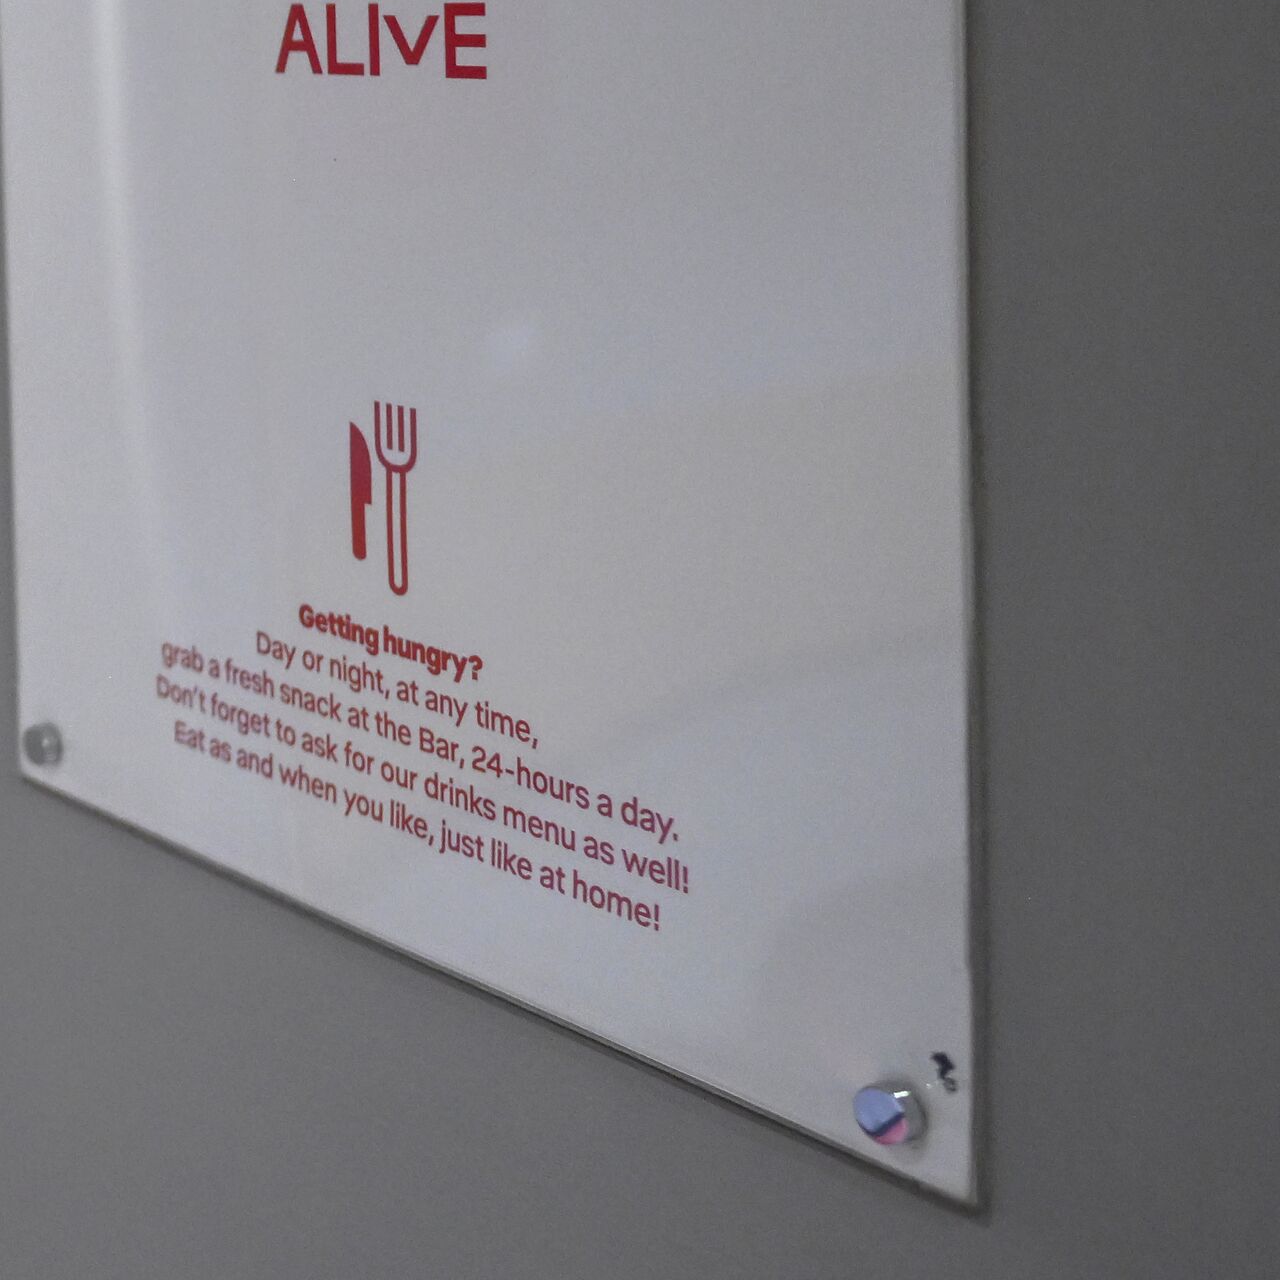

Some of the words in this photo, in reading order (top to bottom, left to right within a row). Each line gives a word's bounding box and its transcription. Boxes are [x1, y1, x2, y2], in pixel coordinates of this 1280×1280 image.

[275, 2, 488, 80] ALIVE
[256, 631, 296, 669] Day
[302, 650, 324, 672] or
[329, 656, 390, 700] night,
[396, 680, 419, 706] at
[425, 690, 468, 727] any
[475, 701, 538, 749] time,
[299, 603, 379, 656] Getting
[383, 625, 483, 682] hungry?
[156, 674, 206, 713] Don't
[211, 692, 271, 737] forget
[276, 719, 296, 747] to
[302, 732, 338, 763] ask
[344, 741, 374, 775] for
[381, 761, 418, 791] our
[424, 772, 496, 821] drinks
[503, 805, 576, 852] menu
[583, 835, 615, 865] as
[621, 848, 689, 894] well!
[161, 642, 203, 673] grab
[208, 658, 220, 678] a
[225, 658, 274, 698] fresh
[280, 682, 341, 722] snack
[347, 706, 369, 731] at
[375, 712, 411, 745] the
[419, 726, 464, 769] Bar,
[471, 745, 590, 809] 24-hours
[596, 793, 613, 818] a
[621, 796, 679, 845] day.
[174, 720, 205, 752] Eat
[209, 737, 232, 763] as
[236, 748, 273, 780] and
[279, 764, 337, 805] when
[343, 787, 383, 823] you
[391, 799, 434, 846] like,
[439, 818, 484, 863] just
[491, 837, 533, 881] like
[540, 865, 566, 895] at
[572, 869, 660, 932] home!
